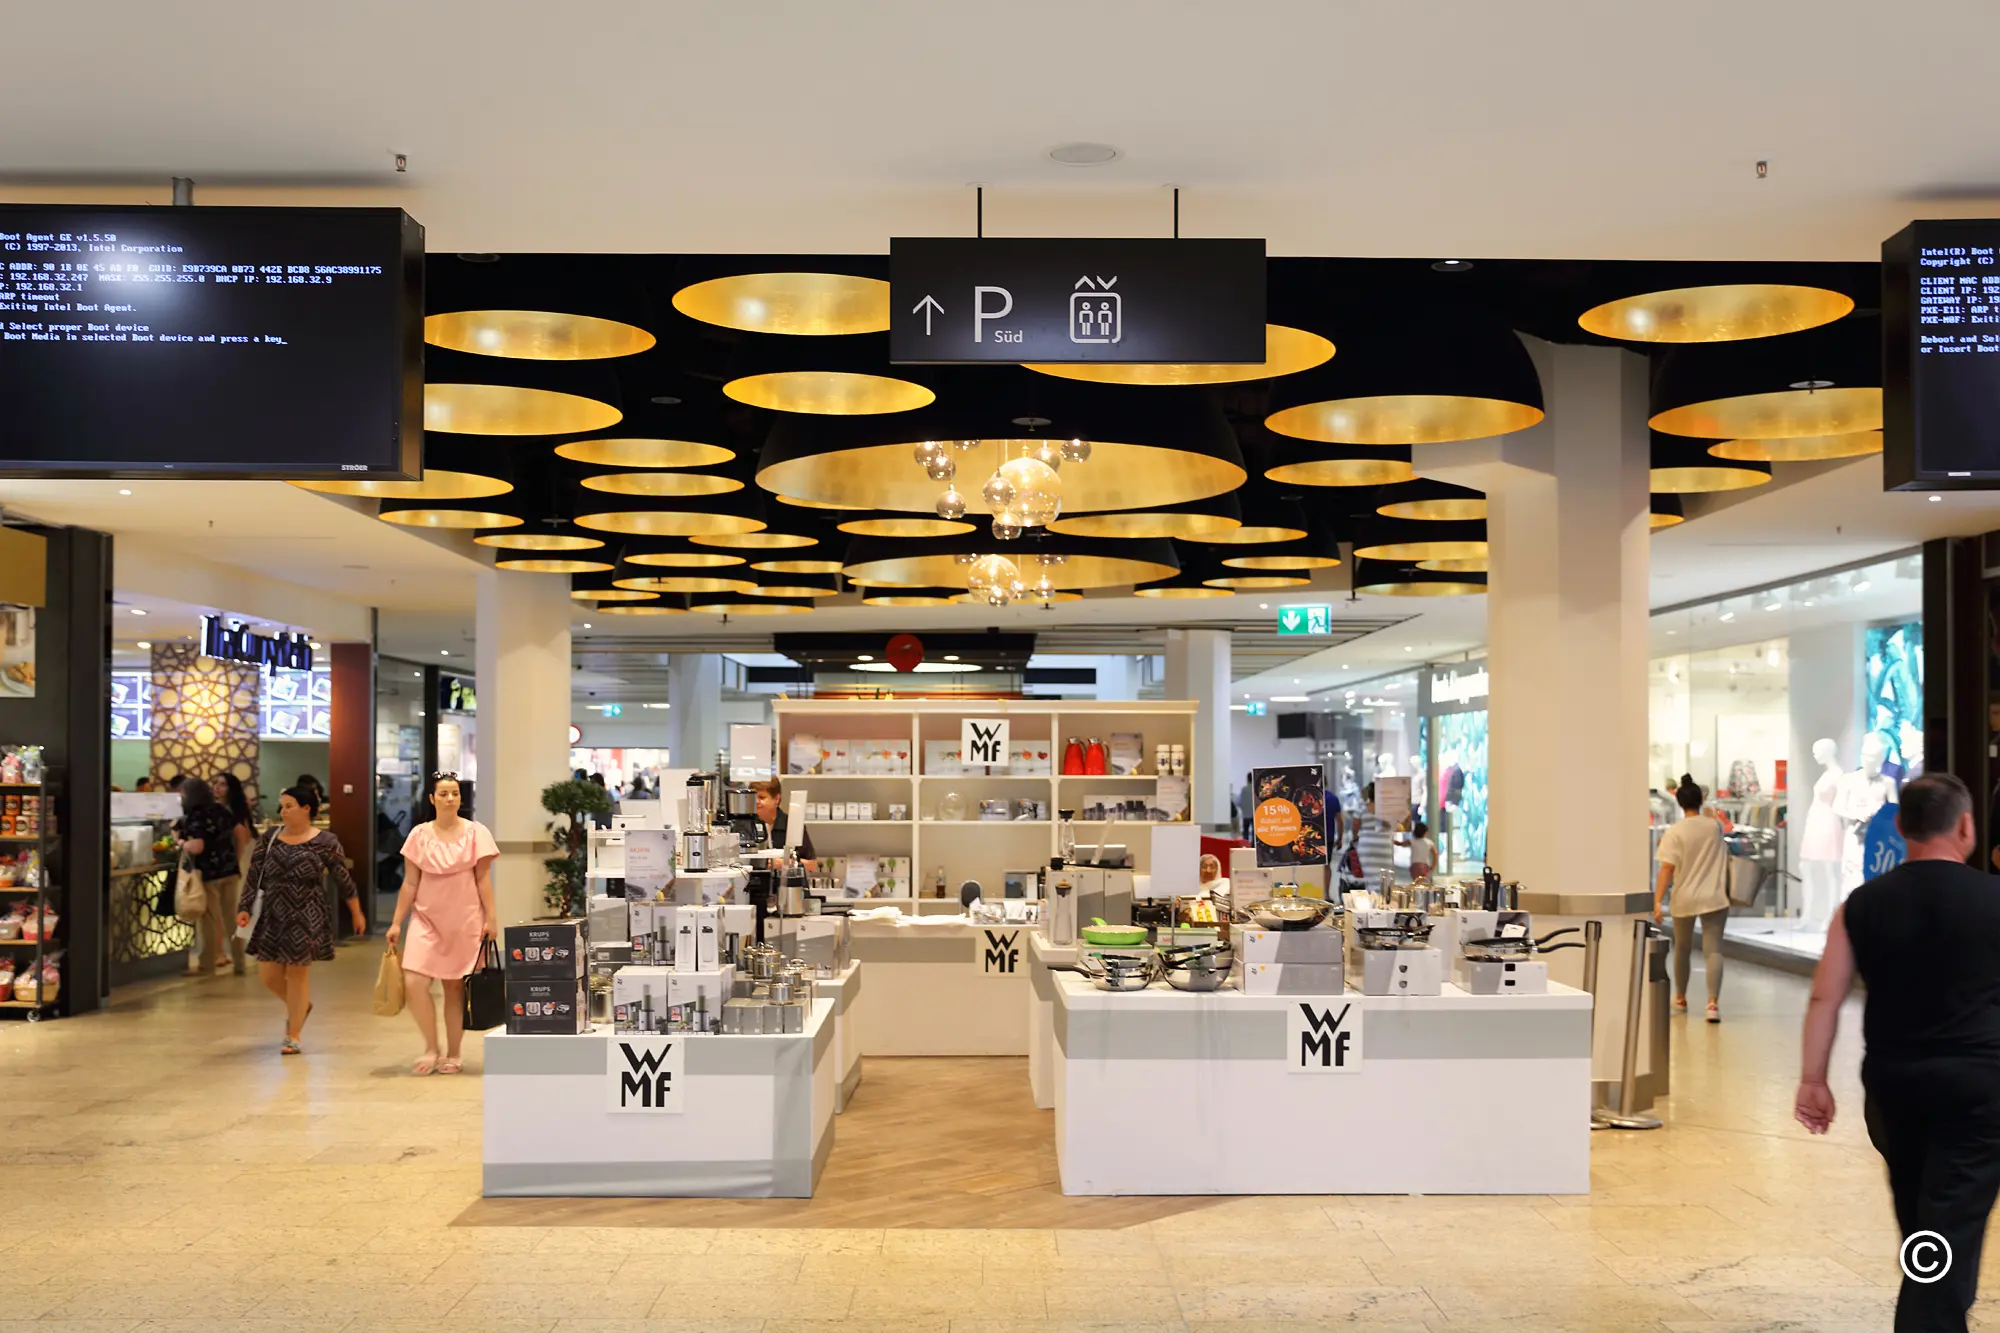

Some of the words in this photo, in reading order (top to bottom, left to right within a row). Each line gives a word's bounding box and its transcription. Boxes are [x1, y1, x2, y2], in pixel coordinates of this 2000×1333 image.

[26, 233, 55, 243] Agent
[60, 234, 72, 242] GE
[5, 243, 21, 251] (C)
[89, 244, 116, 252] Intel
[121, 244, 183, 254] Corporation
[1921, 248, 1966, 256] Intel(R)
[9, 262, 38, 271] ADDR:
[1920, 257, 1971, 267] Copyright
[1977, 257, 1994, 265] (C)
[10, 273, 89, 281] 192.168.32.247
[98, 274, 126, 282] MASK:
[132, 275, 205, 283] 255.255.255.0
[215, 275, 239, 283] DHCP
[265, 275, 333, 284] 192.168.32.9
[1920, 276, 1955, 285] CLIENT
[1959, 276, 1978, 284] MAC
[16, 282, 83, 291] 192.168.32.1
[1920, 286, 1955, 295] CLIENT
[1961, 286, 1977, 294] IP:
[21, 293, 60, 301] timeout
[1920, 296, 1961, 304] GATEWAY
[44, 303, 71, 311] Intel
[76, 303, 99, 311] Boot
[104, 303, 137, 313] Agent.
[1920, 305, 1966, 314] PXE-E11:
[1970, 305, 1989, 313] ARP
[974, 286, 1014, 343] P
[994, 330, 1024, 344] Süd
[9, 322, 43, 330] Select
[48, 324, 83, 333] proper
[87, 323, 110, 332] Boot
[115, 323, 150, 332] device
[4, 332, 26, 340] Boot
[31, 332, 61, 341] Media
[66, 332, 77, 341] in
[82, 333, 127, 342] selected
[132, 333, 154, 342] Boot
[159, 333, 194, 342] device
[198, 334, 215, 342] and
[220, 335, 249, 345] press
[1920, 335, 1955, 343] Reboot
[1960, 335, 1978, 343] and
[1939, 345, 1971, 353] Insert
[1977, 344, 1999, 353] Boot
